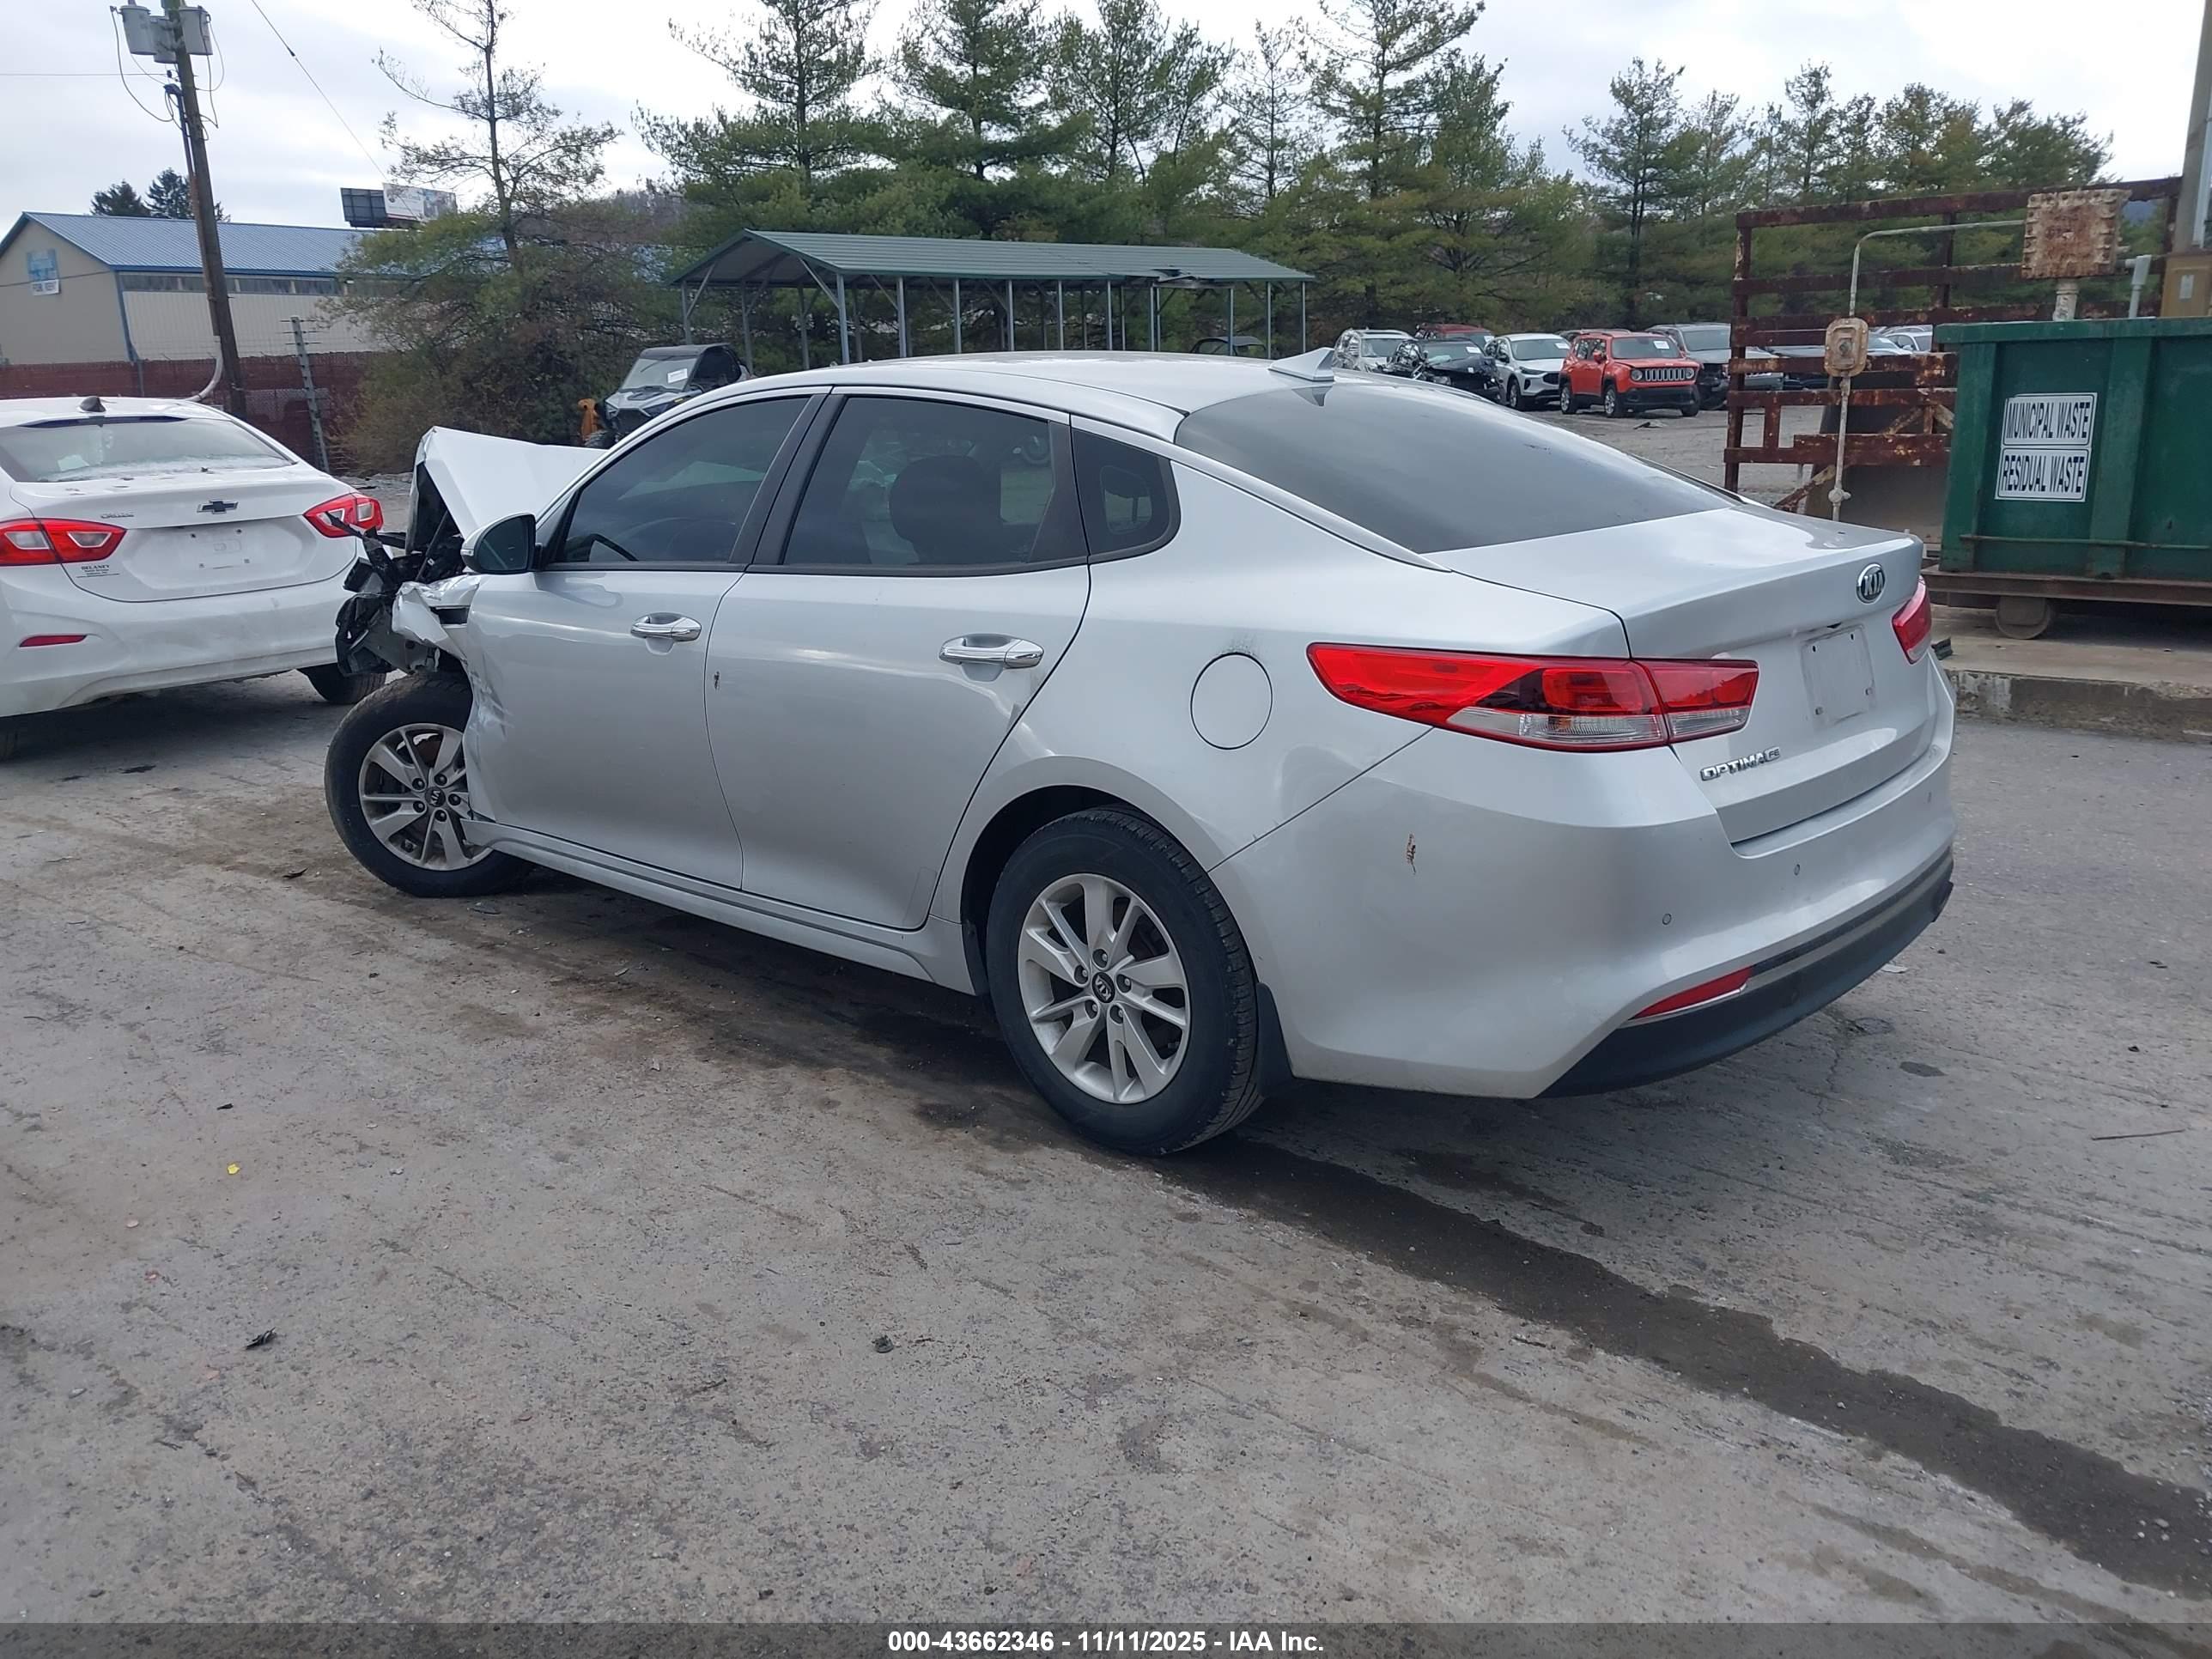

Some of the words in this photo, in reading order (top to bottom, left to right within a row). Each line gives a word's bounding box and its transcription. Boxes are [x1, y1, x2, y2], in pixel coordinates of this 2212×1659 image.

[2006, 402, 2055, 439] MUNICIPAL
[2057, 401, 2091, 439] WASTE
[2001, 454, 2047, 492] RESIDUAL
[2049, 455, 2086, 493] WASTE
[1700, 752, 1765, 781] OPTIMA
[1095, 975, 1112, 1000] KIA
